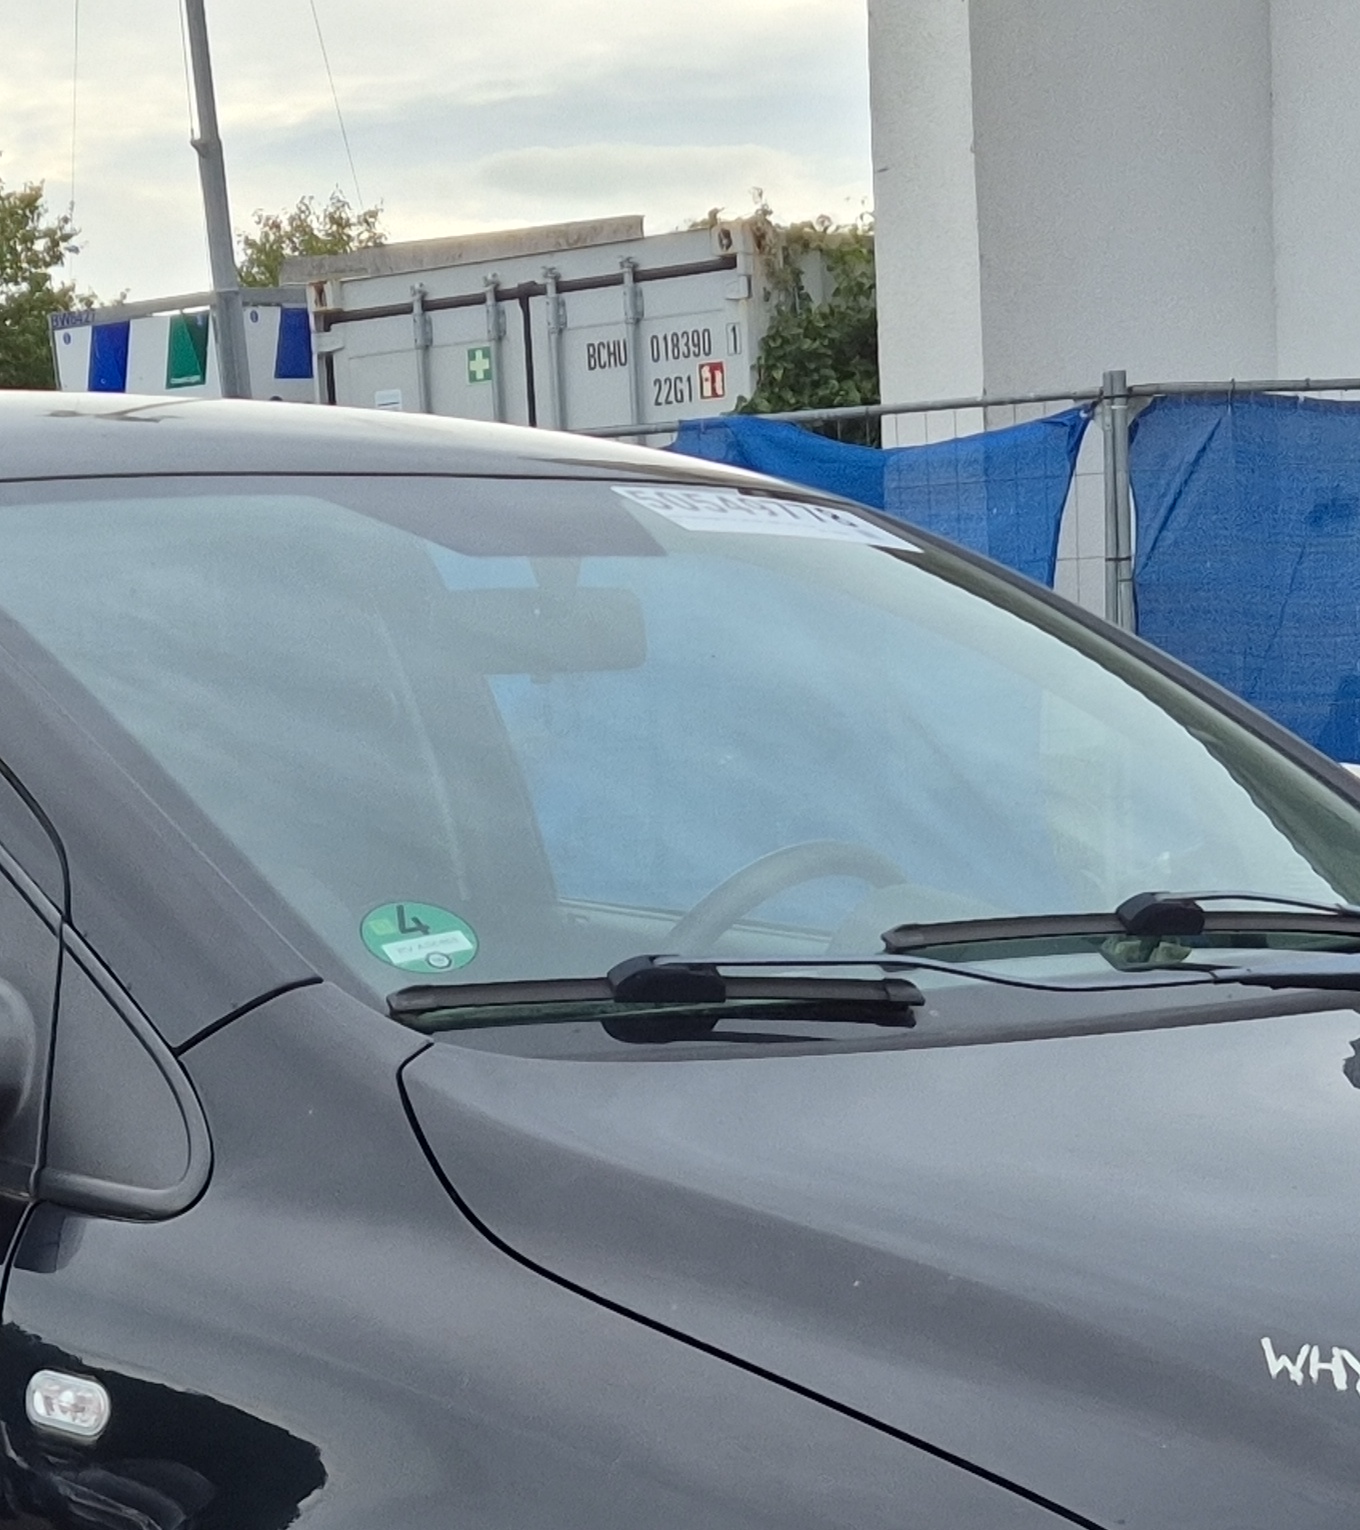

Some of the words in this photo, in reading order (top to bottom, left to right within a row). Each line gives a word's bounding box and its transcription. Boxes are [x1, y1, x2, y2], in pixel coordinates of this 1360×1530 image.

[586, 338, 628, 371] BCHU
[650, 328, 712, 363] 018390
[729, 324, 739, 354] 1
[653, 374, 693, 406] 22G1
[396, 904, 431, 935] 4
